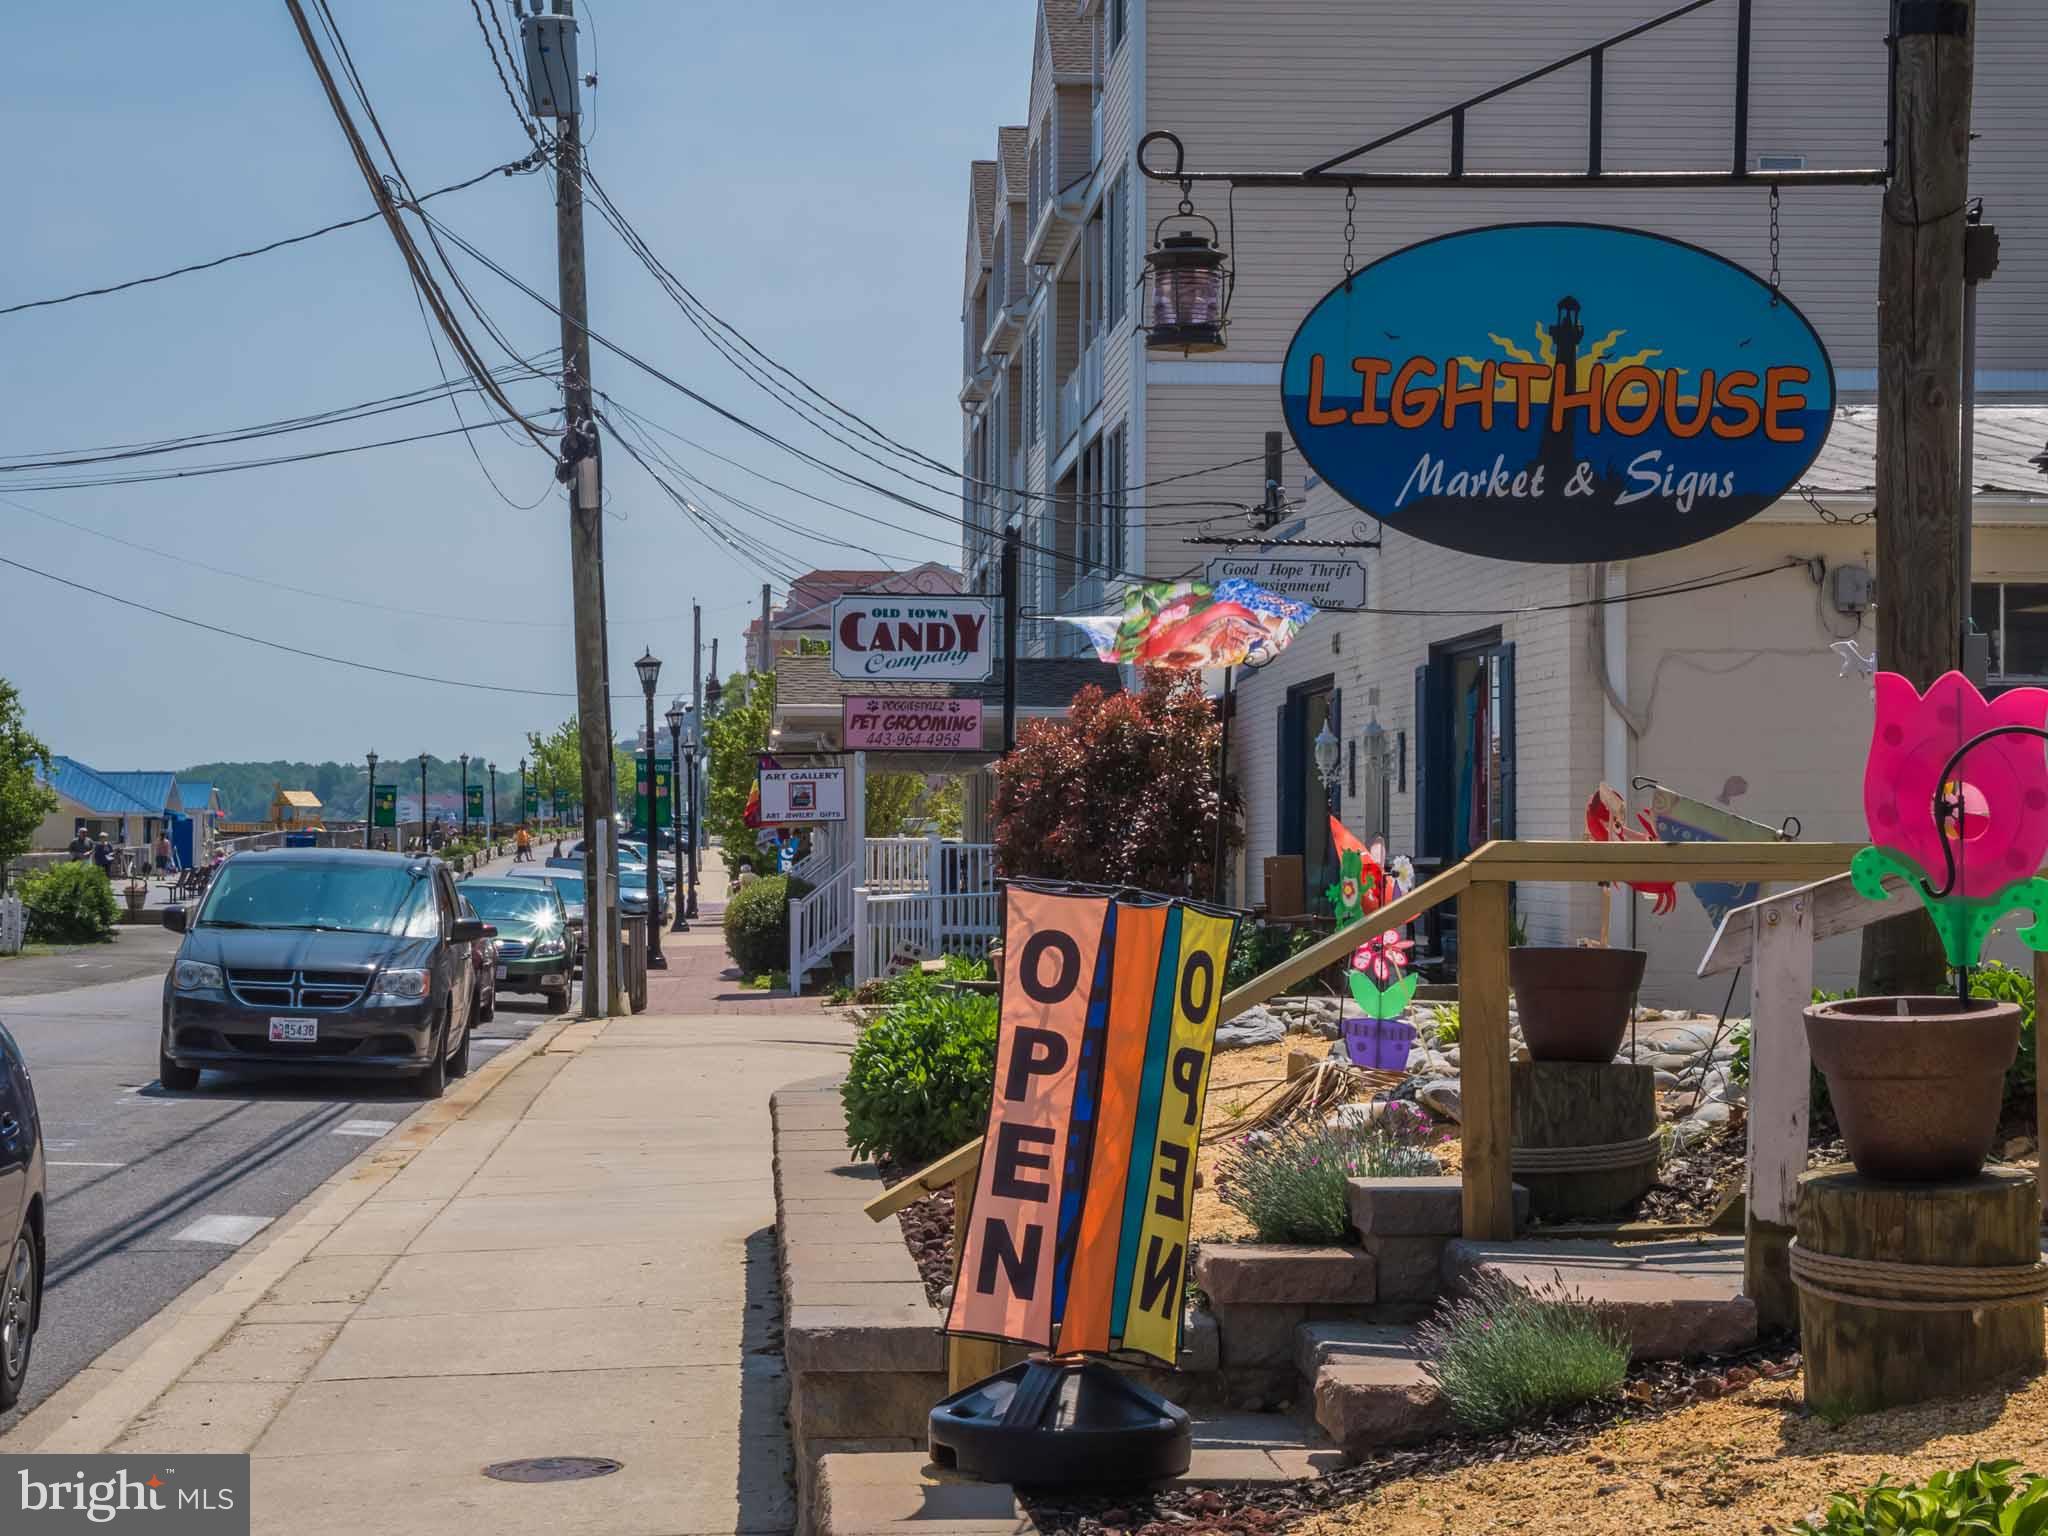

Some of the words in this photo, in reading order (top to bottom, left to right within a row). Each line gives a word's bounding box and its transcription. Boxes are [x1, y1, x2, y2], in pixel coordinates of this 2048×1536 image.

[1306, 354, 1810, 442] LIGHTHOUSE
[1395, 451, 1545, 507] Market
[1563, 462, 1594, 498] &
[1614, 449, 1735, 513] Signs
[1222, 562, 1260, 576] Good
[1269, 563, 1304, 580] Hope
[1310, 563, 1352, 580] Thrift
[1311, 595, 1345, 608] Store
[871, 608, 900, 619] OLD
[907, 608, 948, 619] TOWN
[839, 611, 986, 653] CANDY
[864, 649, 969, 675] Company
[849, 714, 881, 730] PET
[883, 714, 977, 732] GROOMING
[765, 773, 786, 781] ART
[790, 772, 840, 780] GALLERY
[975, 928, 1081, 1301] OPEN
